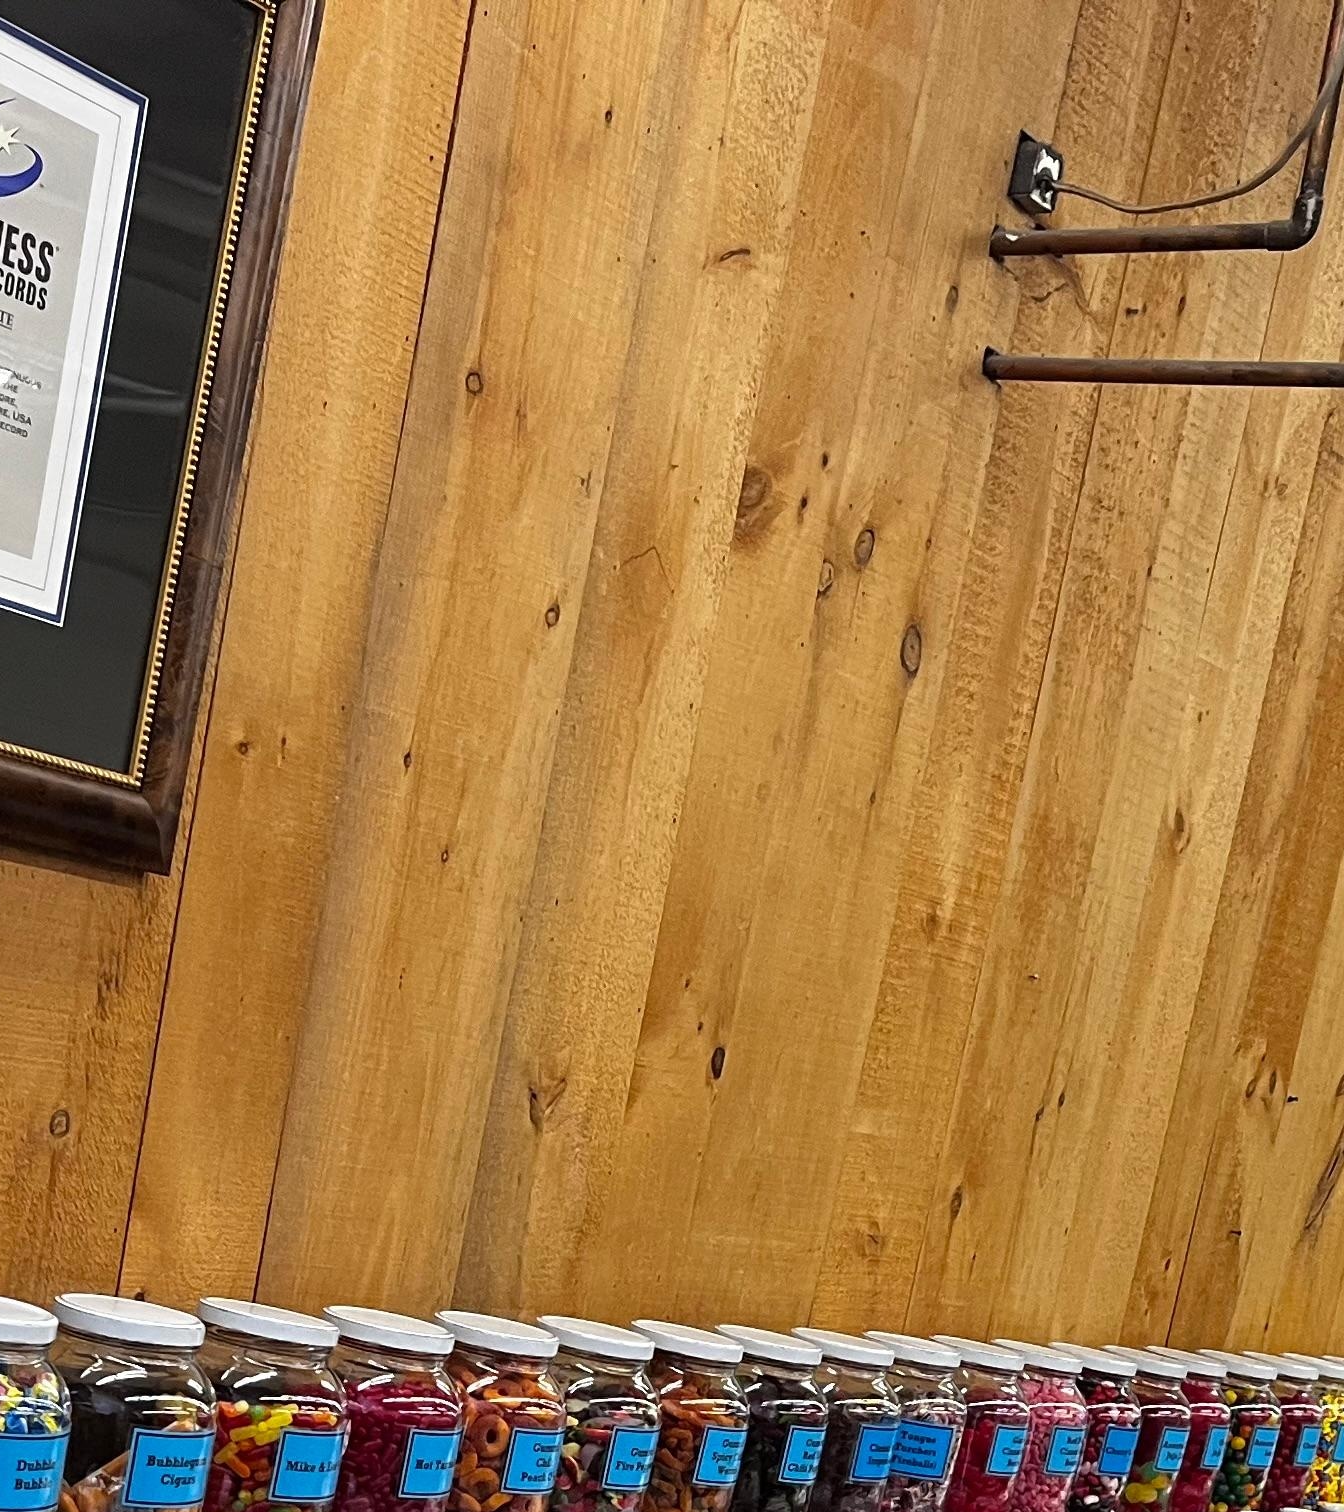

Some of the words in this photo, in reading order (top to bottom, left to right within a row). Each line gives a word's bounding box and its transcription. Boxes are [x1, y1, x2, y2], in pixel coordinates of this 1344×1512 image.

[12, 410, 32, 426] USA
[285, 1461, 316, 1473] Mike
[415, 1459, 435, 1470] Hot
[160, 1474, 196, 1489] Cigars
